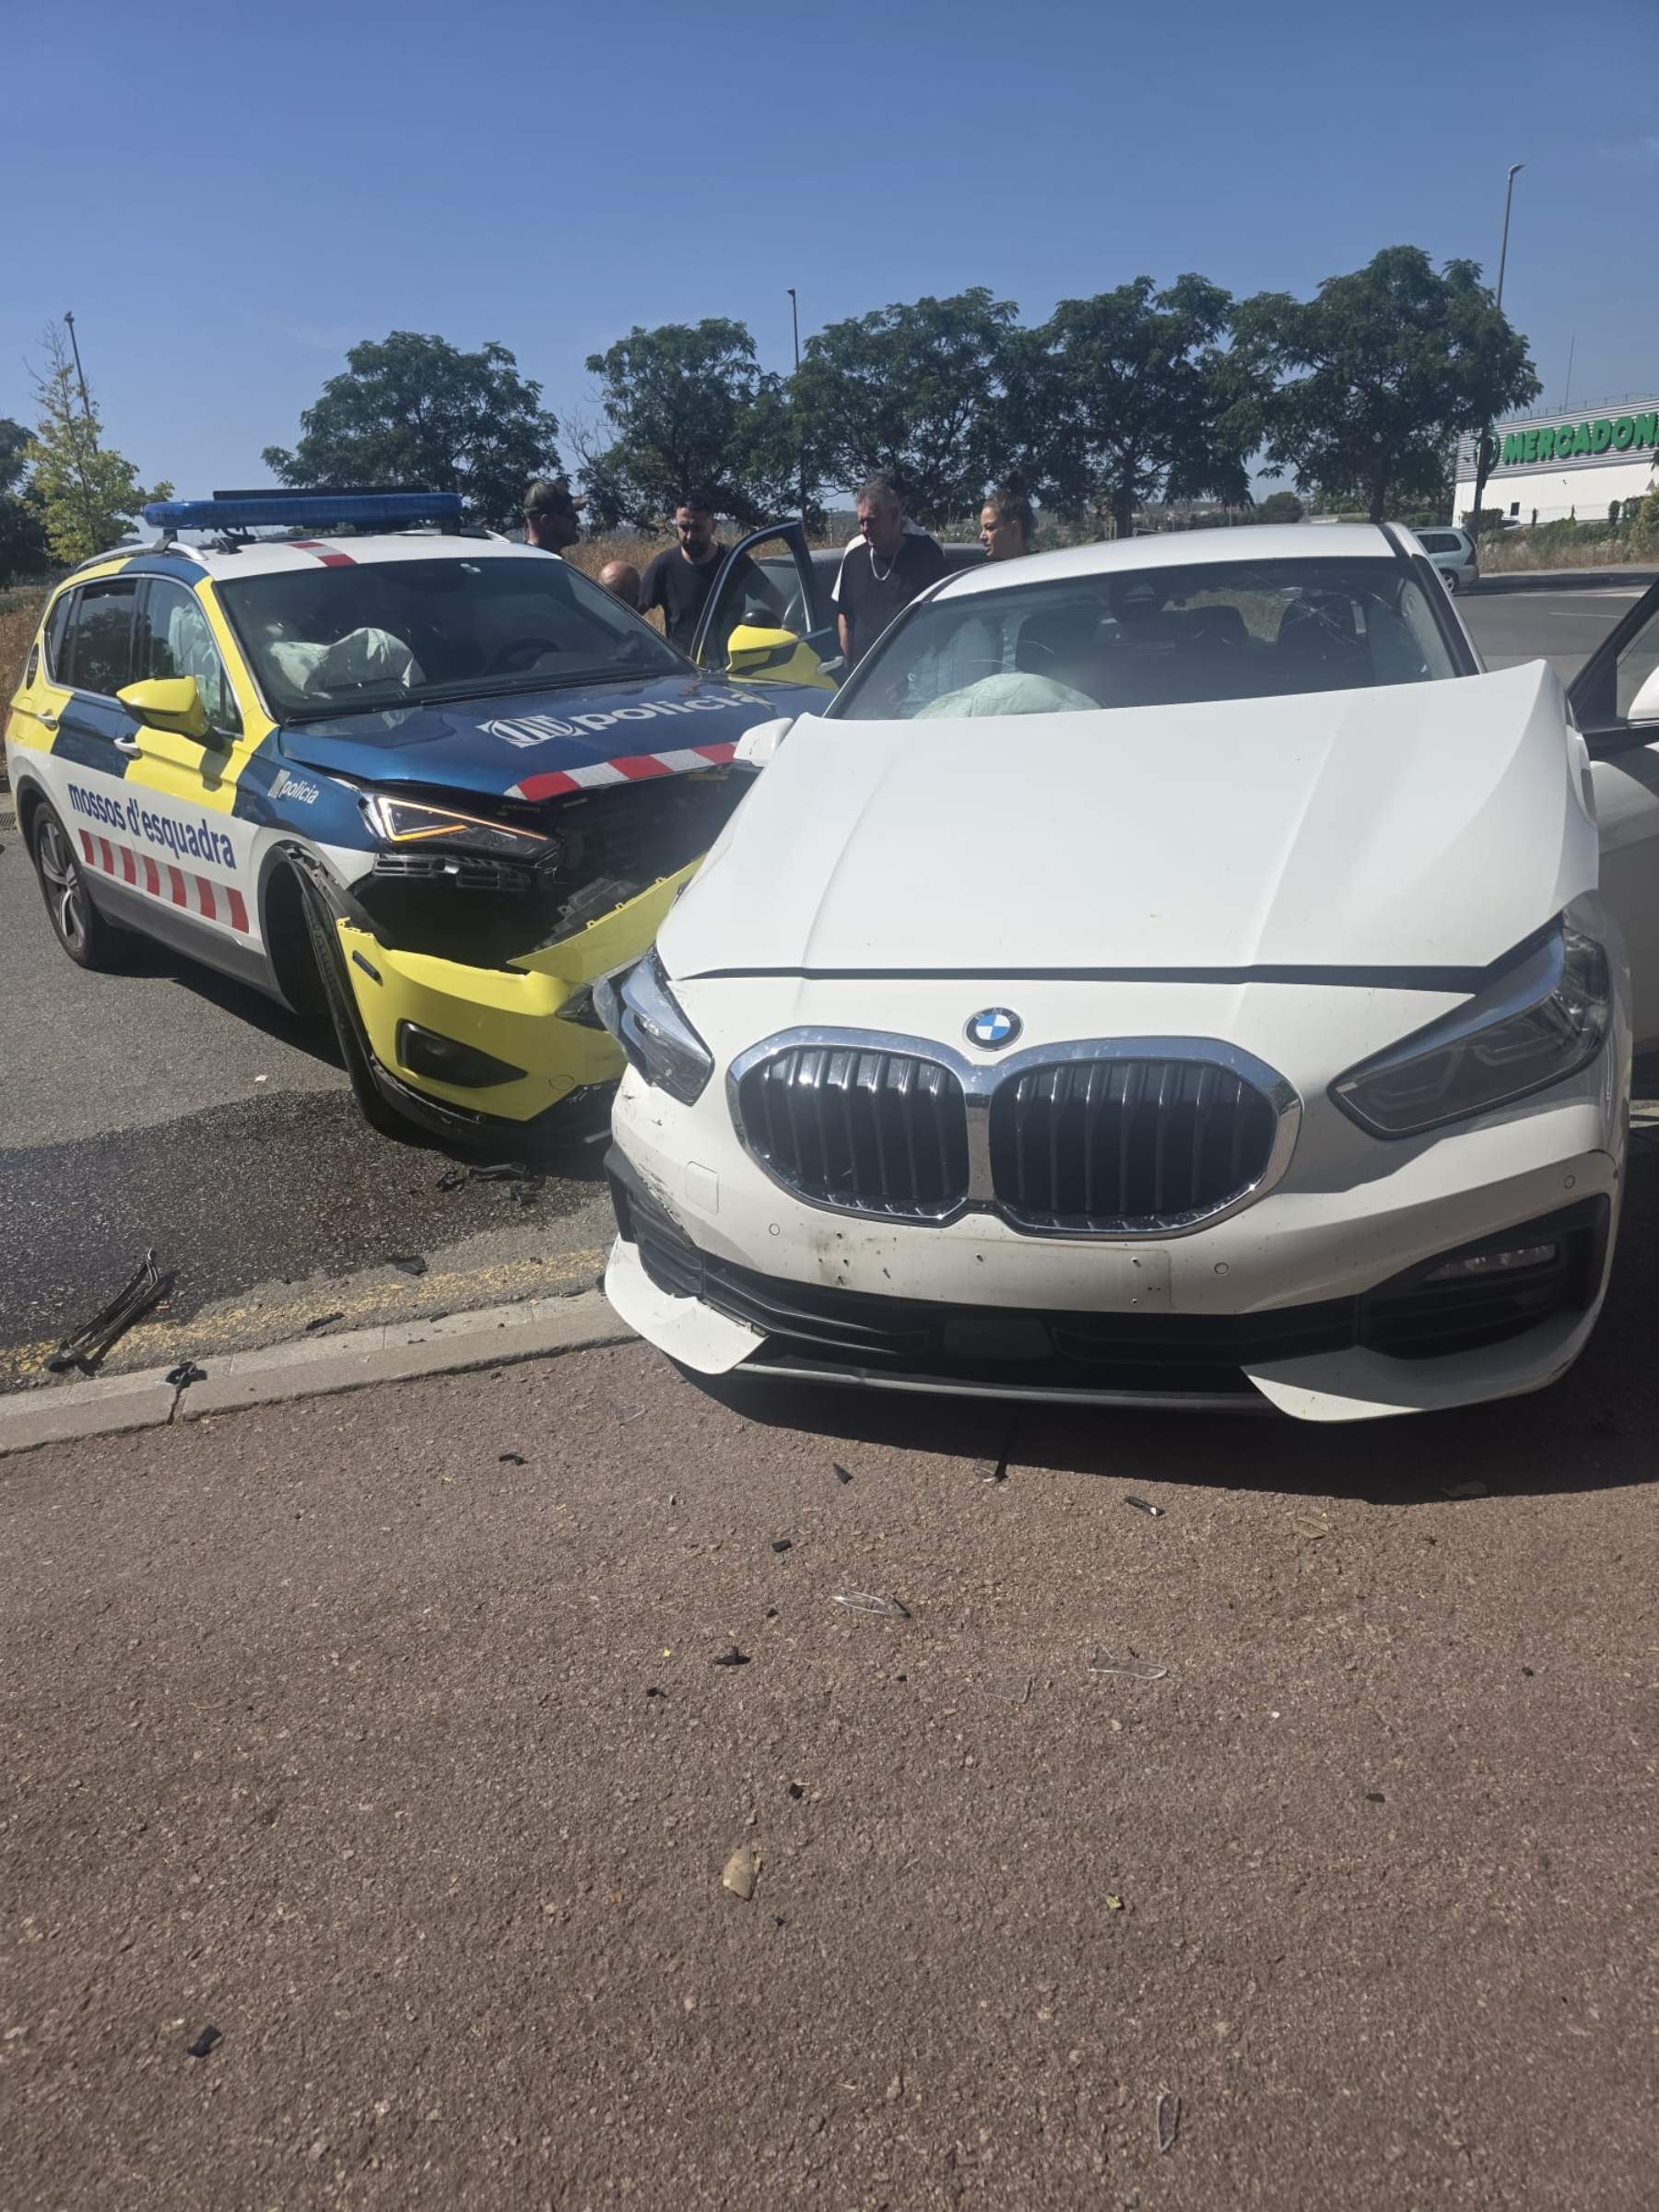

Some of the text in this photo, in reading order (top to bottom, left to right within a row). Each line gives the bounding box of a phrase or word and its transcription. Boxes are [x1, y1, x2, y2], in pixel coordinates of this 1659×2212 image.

[1503, 412, 1659, 464] MERCADON
[278, 780, 320, 805] policia
[67, 782, 237, 870] mossos d'esquadra
